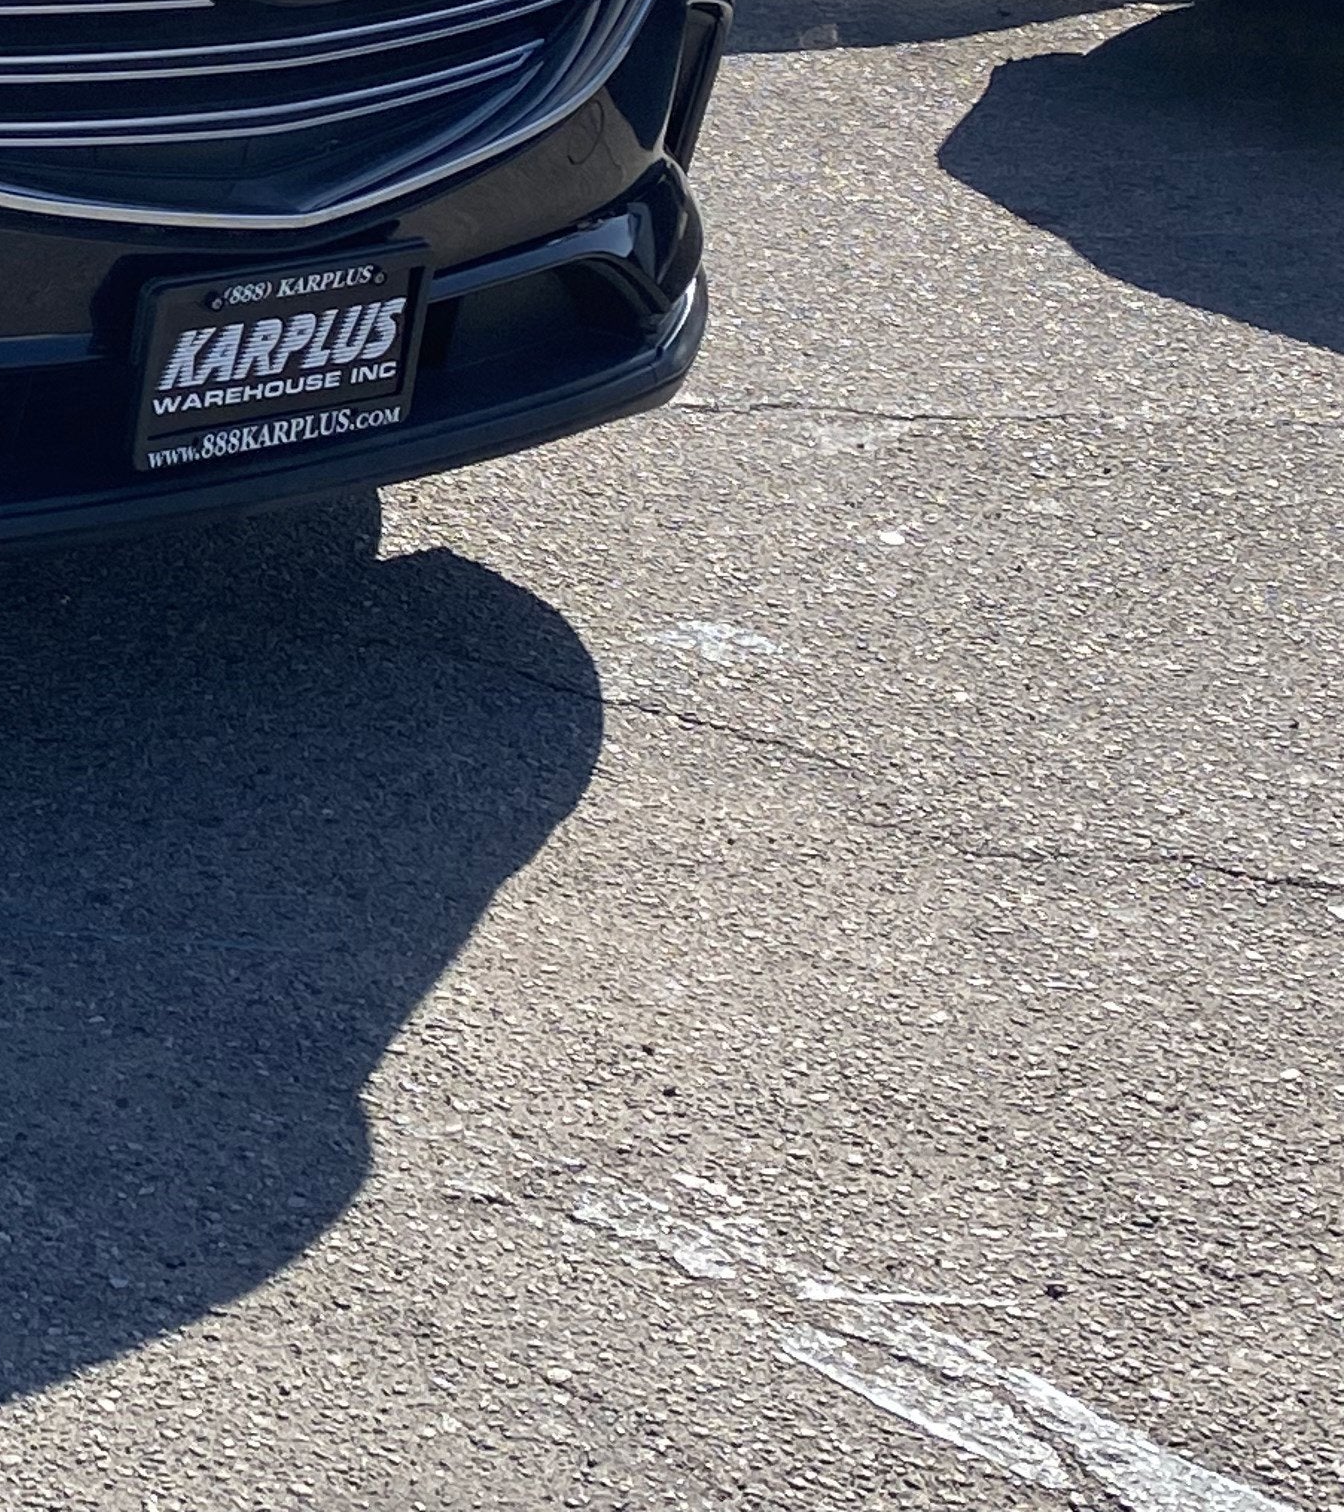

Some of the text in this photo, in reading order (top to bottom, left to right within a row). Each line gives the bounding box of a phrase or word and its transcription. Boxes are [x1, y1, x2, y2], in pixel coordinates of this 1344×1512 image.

[223, 265, 374, 305] (888) KARPLUS
[155, 296, 407, 391] KARPLUS
[152, 361, 397, 416] WAREHOUSE INC
